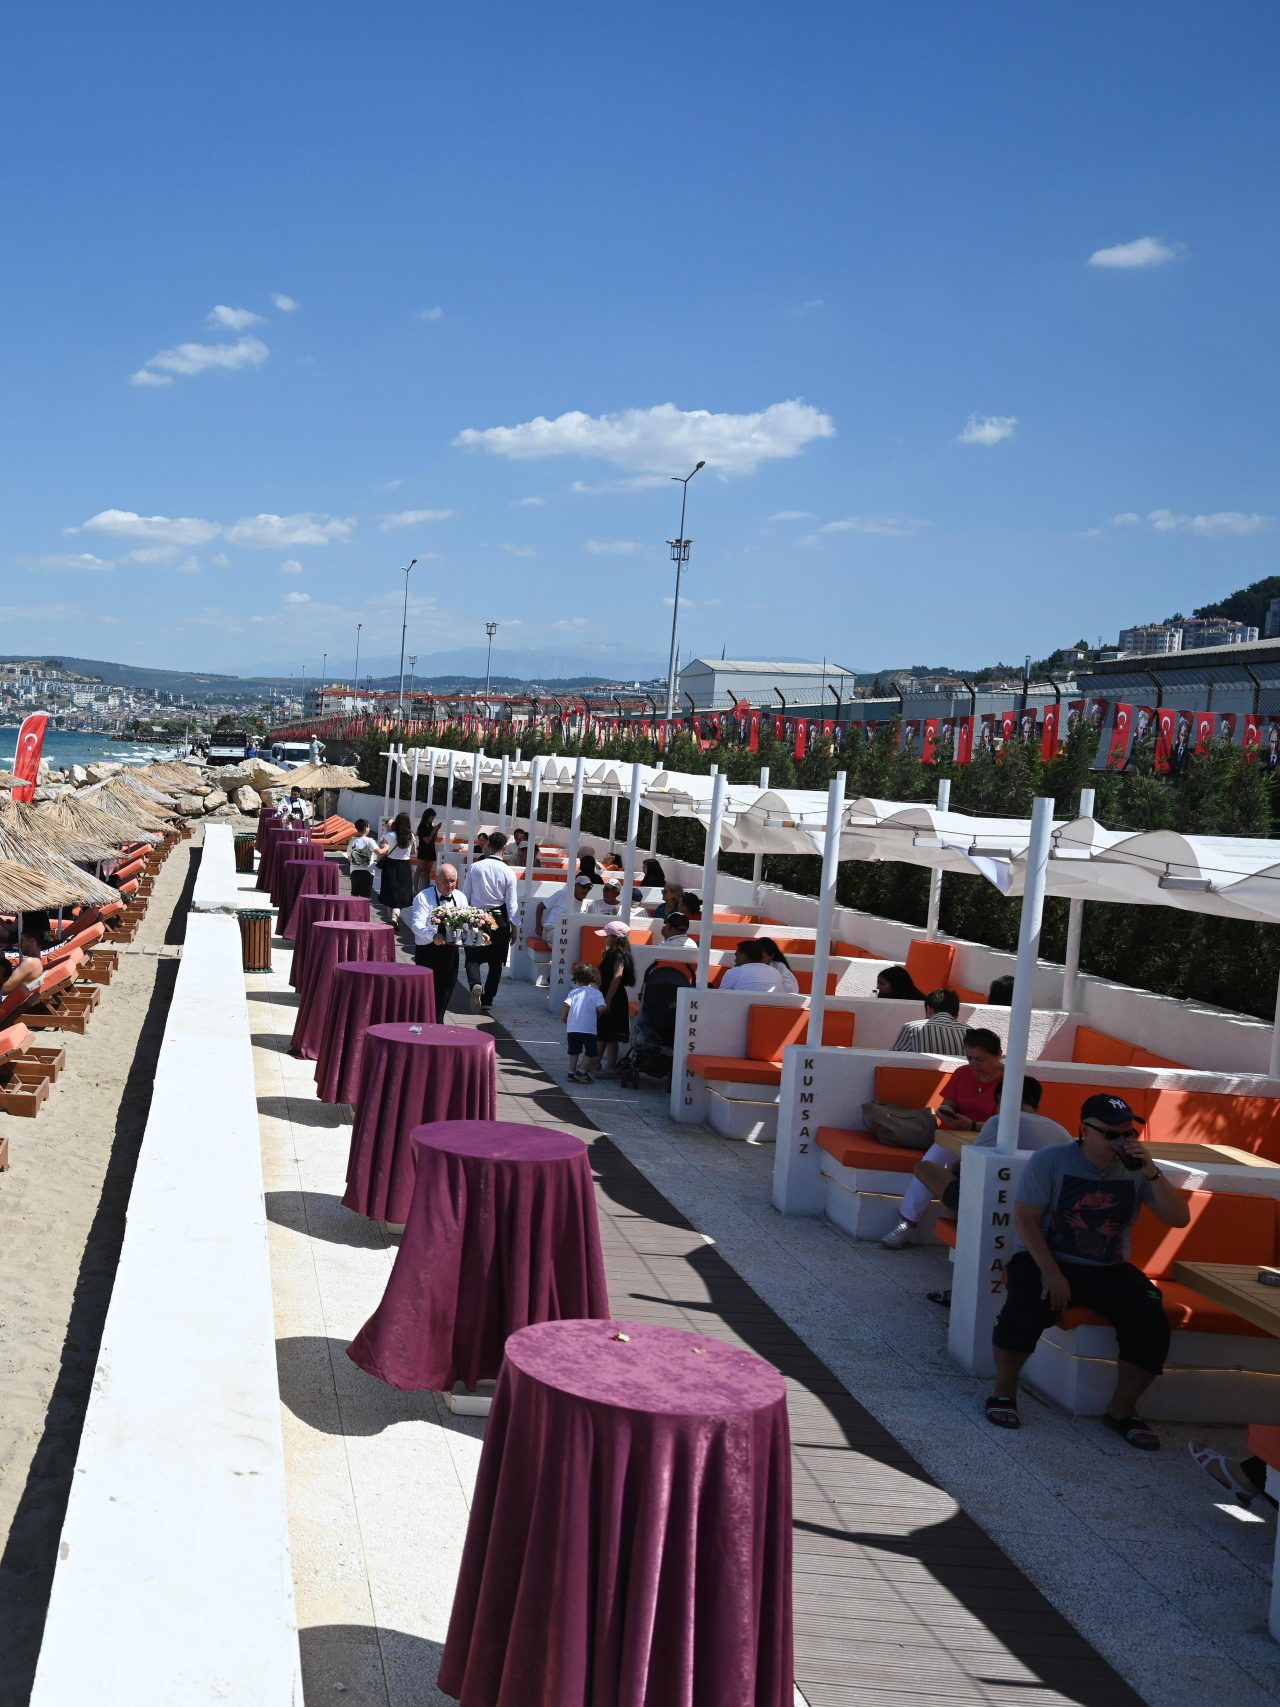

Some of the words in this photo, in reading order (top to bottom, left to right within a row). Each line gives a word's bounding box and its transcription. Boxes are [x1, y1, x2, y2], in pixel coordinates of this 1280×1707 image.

[557, 918, 568, 985] KUMYAKA
[684, 1000, 698, 1106] KURŞNLU
[799, 1058, 815, 1154] KUMSAZ
[1108, 1098, 1127, 1109] NY
[990, 1167, 1011, 1294] GEMSAZ
[1081, 1192, 1113, 1206] NIKE
